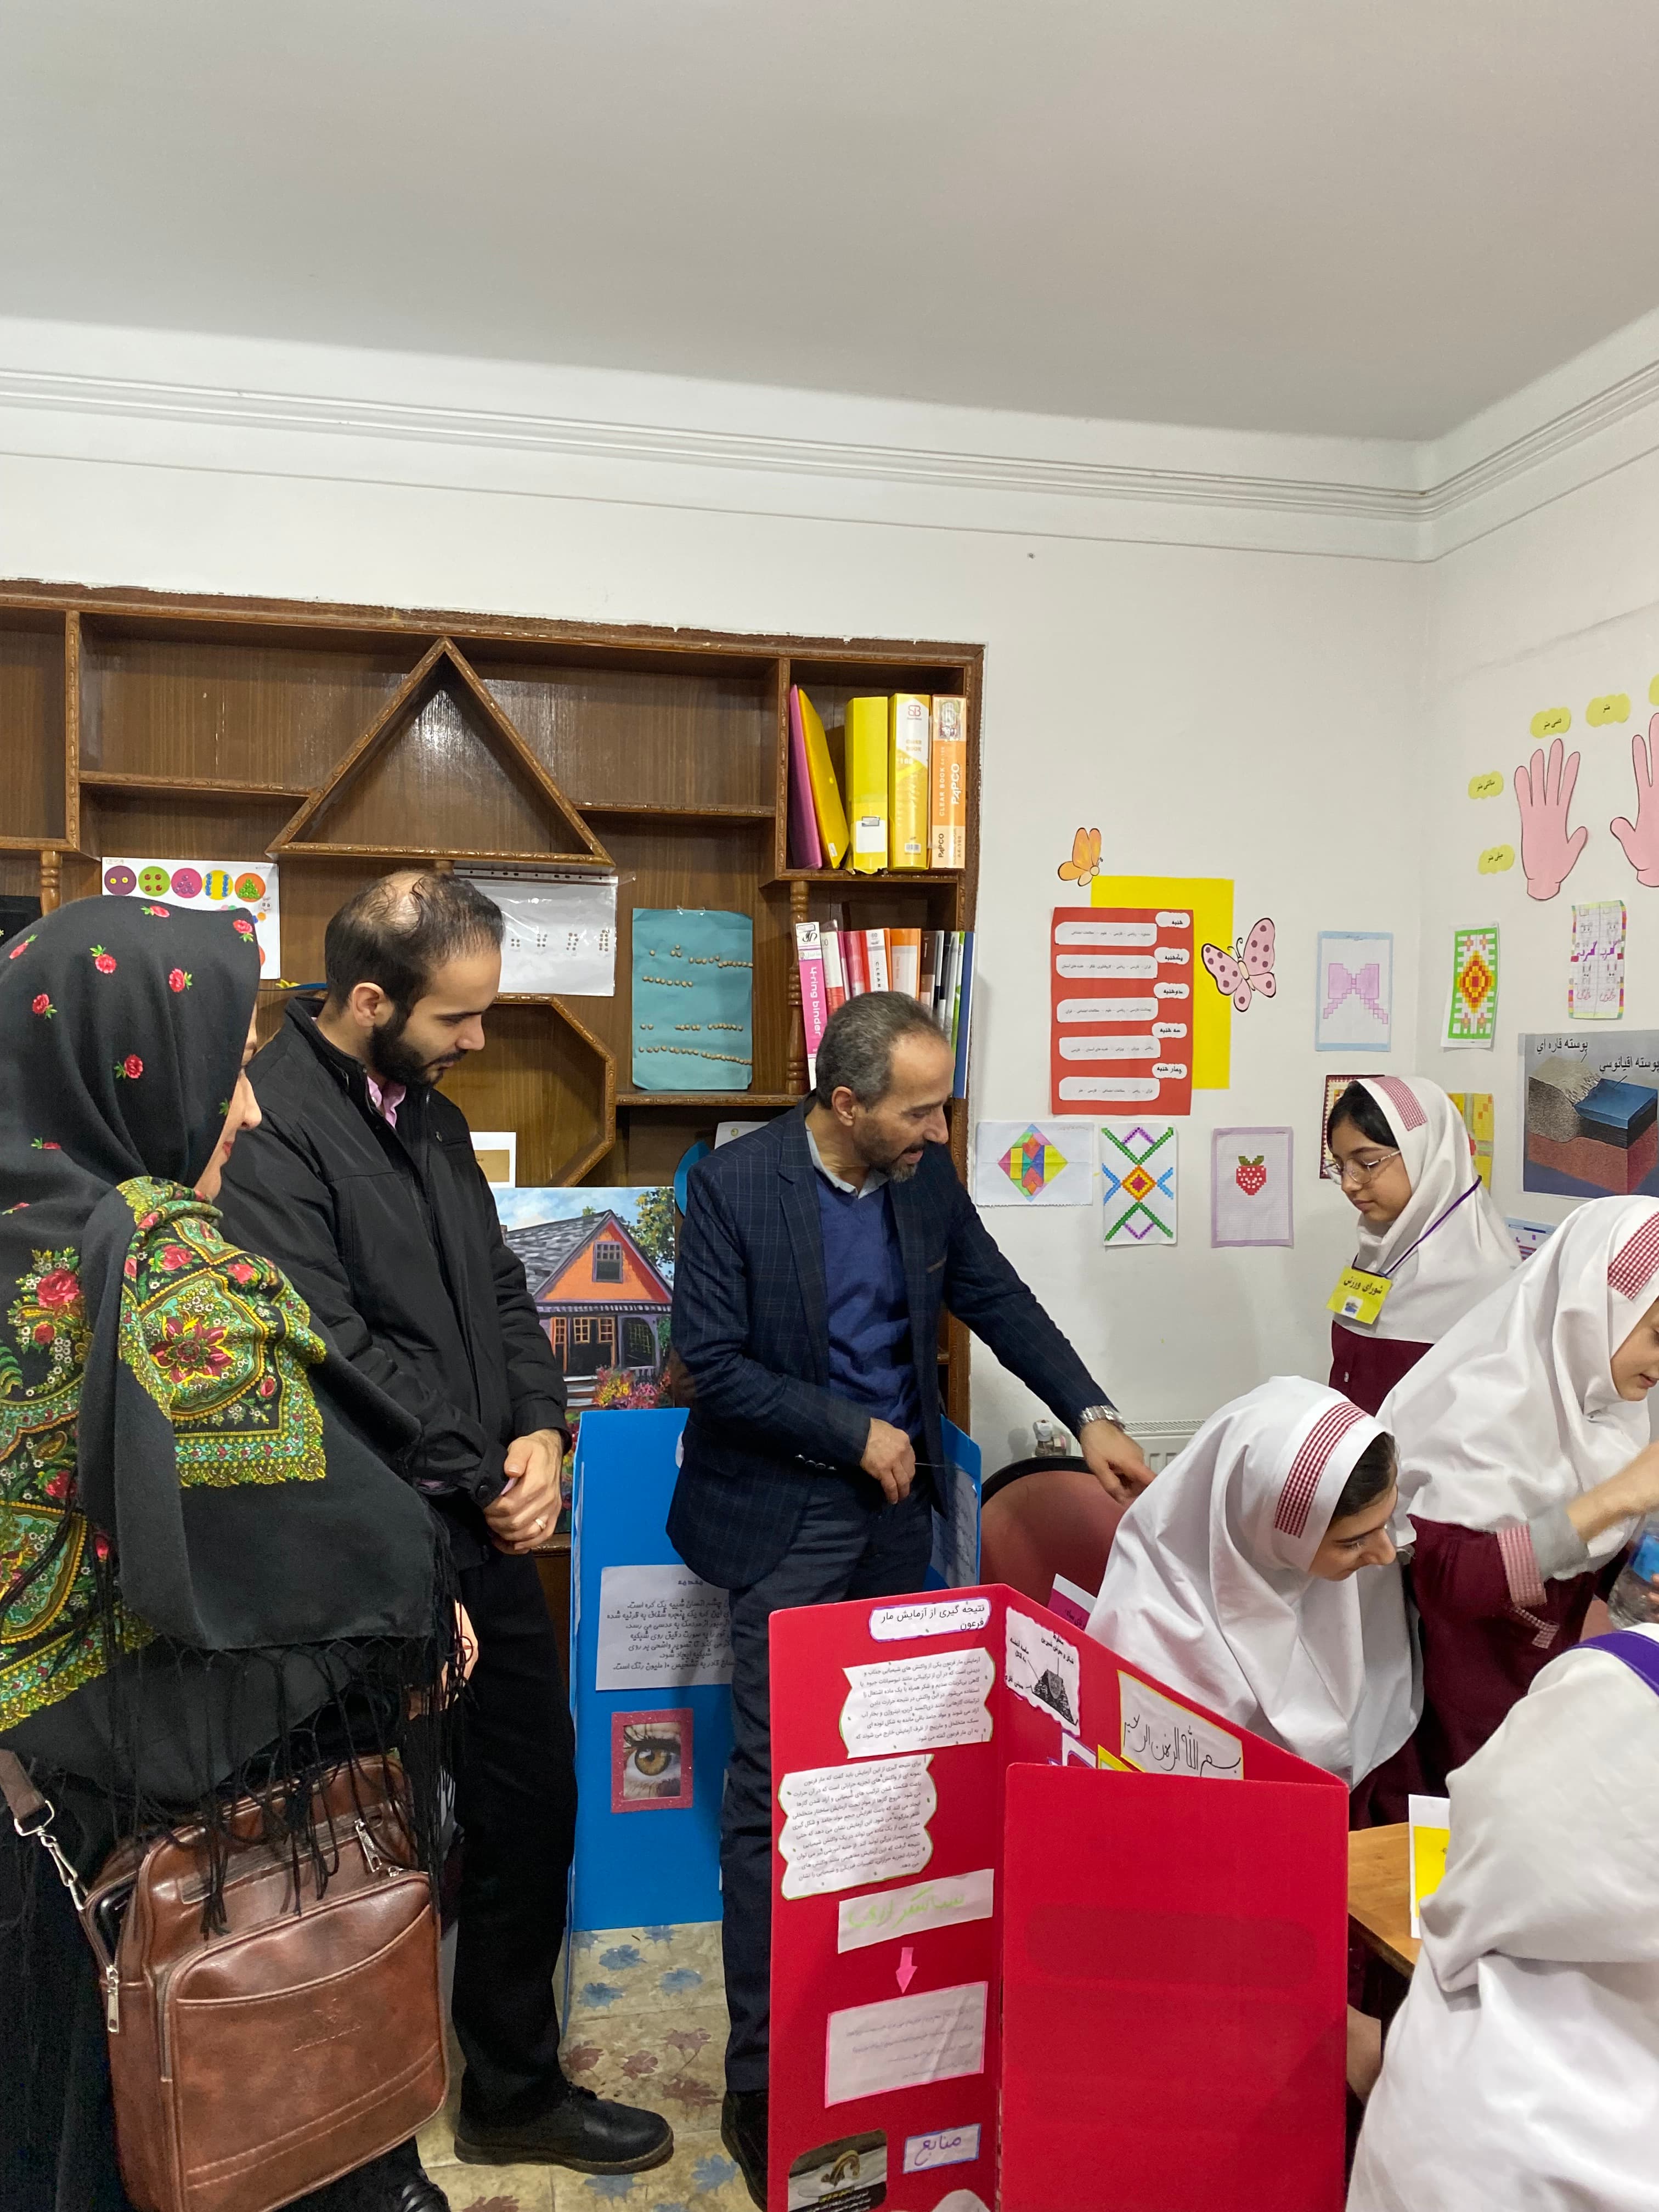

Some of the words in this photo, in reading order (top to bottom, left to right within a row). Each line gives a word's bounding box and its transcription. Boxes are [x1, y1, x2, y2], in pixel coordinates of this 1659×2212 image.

[950, 763, 961, 804] PAPCO
[810, 967, 819, 998] 4-ring
[812, 1001, 821, 1036] binder
[1548, 1037, 1562, 1052] قاره
[1564, 1037, 1588, 1052] پوسته
[1362, 1283, 1383, 1295] شورای
[645, 1600, 655, 1609] کره
[657, 1600, 666, 1609] یک
[669, 1598, 685, 1610] شبیه
[686, 1599, 705, 1609] انسان
[962, 1602, 985, 1614] نتیجه
[606, 1610, 621, 1618] شده
[622, 1611, 639, 1620] قرنیه
[668, 1610, 685, 1620] پنجره
[687, 1610, 697, 1619] یک
[896, 1607, 928, 1622] آزمایش
[929, 1607, 936, 1618] از
[939, 1605, 960, 1618] گیری
[881, 1612, 894, 1624] مار
[960, 1618, 984, 1632] فرعون
[630, 1630, 649, 1641] شبکیه
[665, 1631, 681, 1640] دقیق
[651, 1641, 672, 1650] واضحی
[674, 1641, 693, 1650] تصویر
[677, 1651, 691, 1660] ایجاد
[693, 1647, 712, 1658] شبکیه
[645, 1661, 663, 1671] ملیون
[671, 1659, 698, 1670] تشخیص
[1200, 1754, 1241, 1777] بسم
[915, 2135, 962, 2166] منابع
